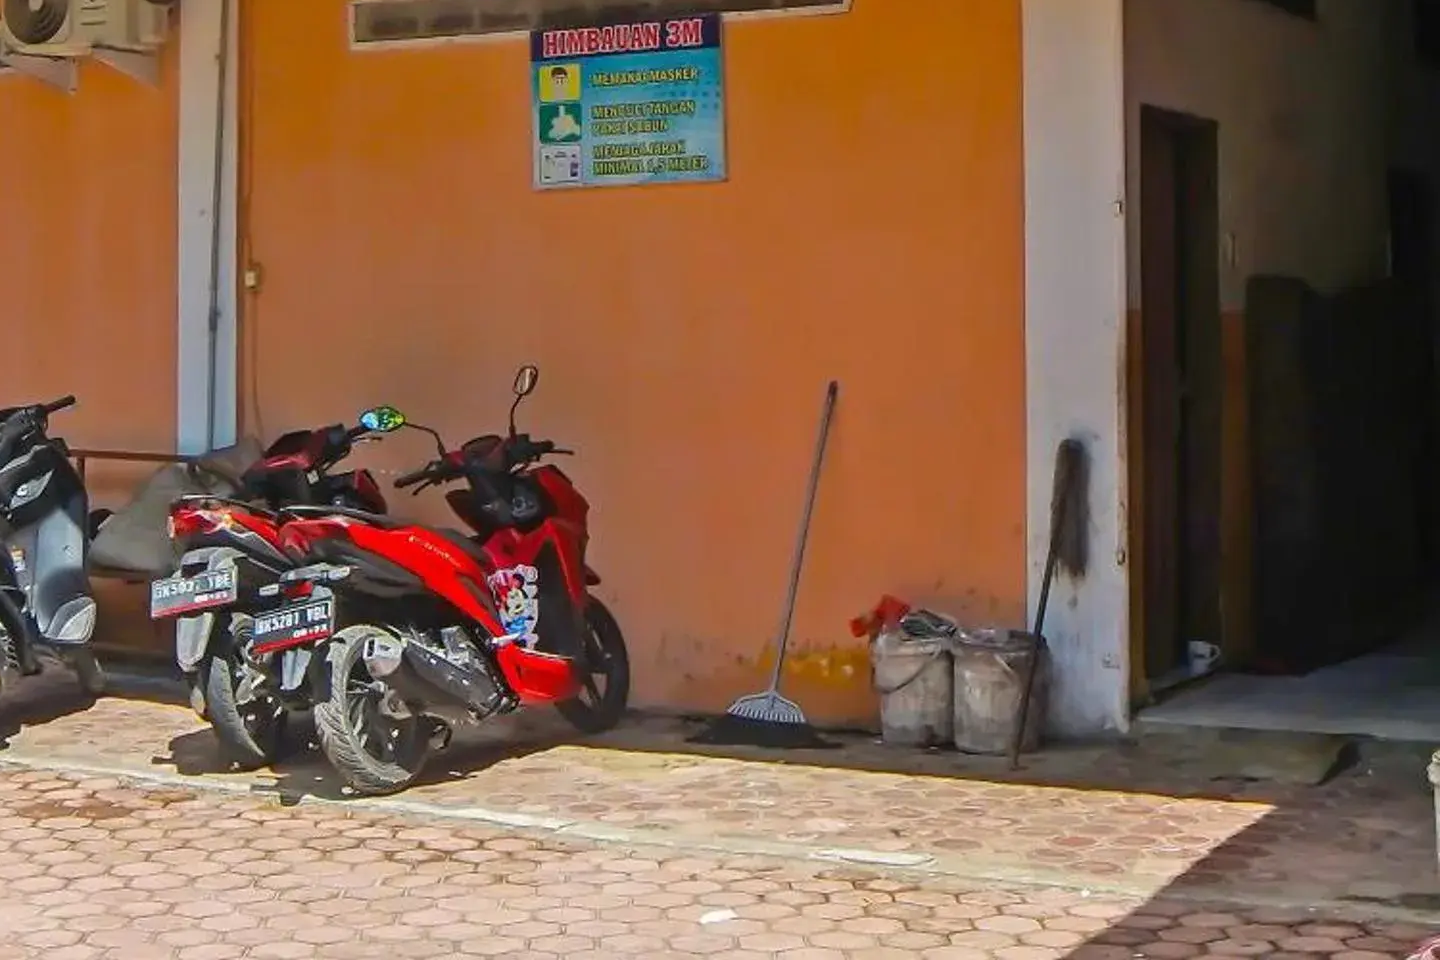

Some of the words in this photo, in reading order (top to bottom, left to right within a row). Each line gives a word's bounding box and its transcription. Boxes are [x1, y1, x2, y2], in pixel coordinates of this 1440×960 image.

[543, 23, 660, 58] HIMBAUAN
[665, 19, 703, 47] 3M
[649, 67, 699, 82] MASKER
